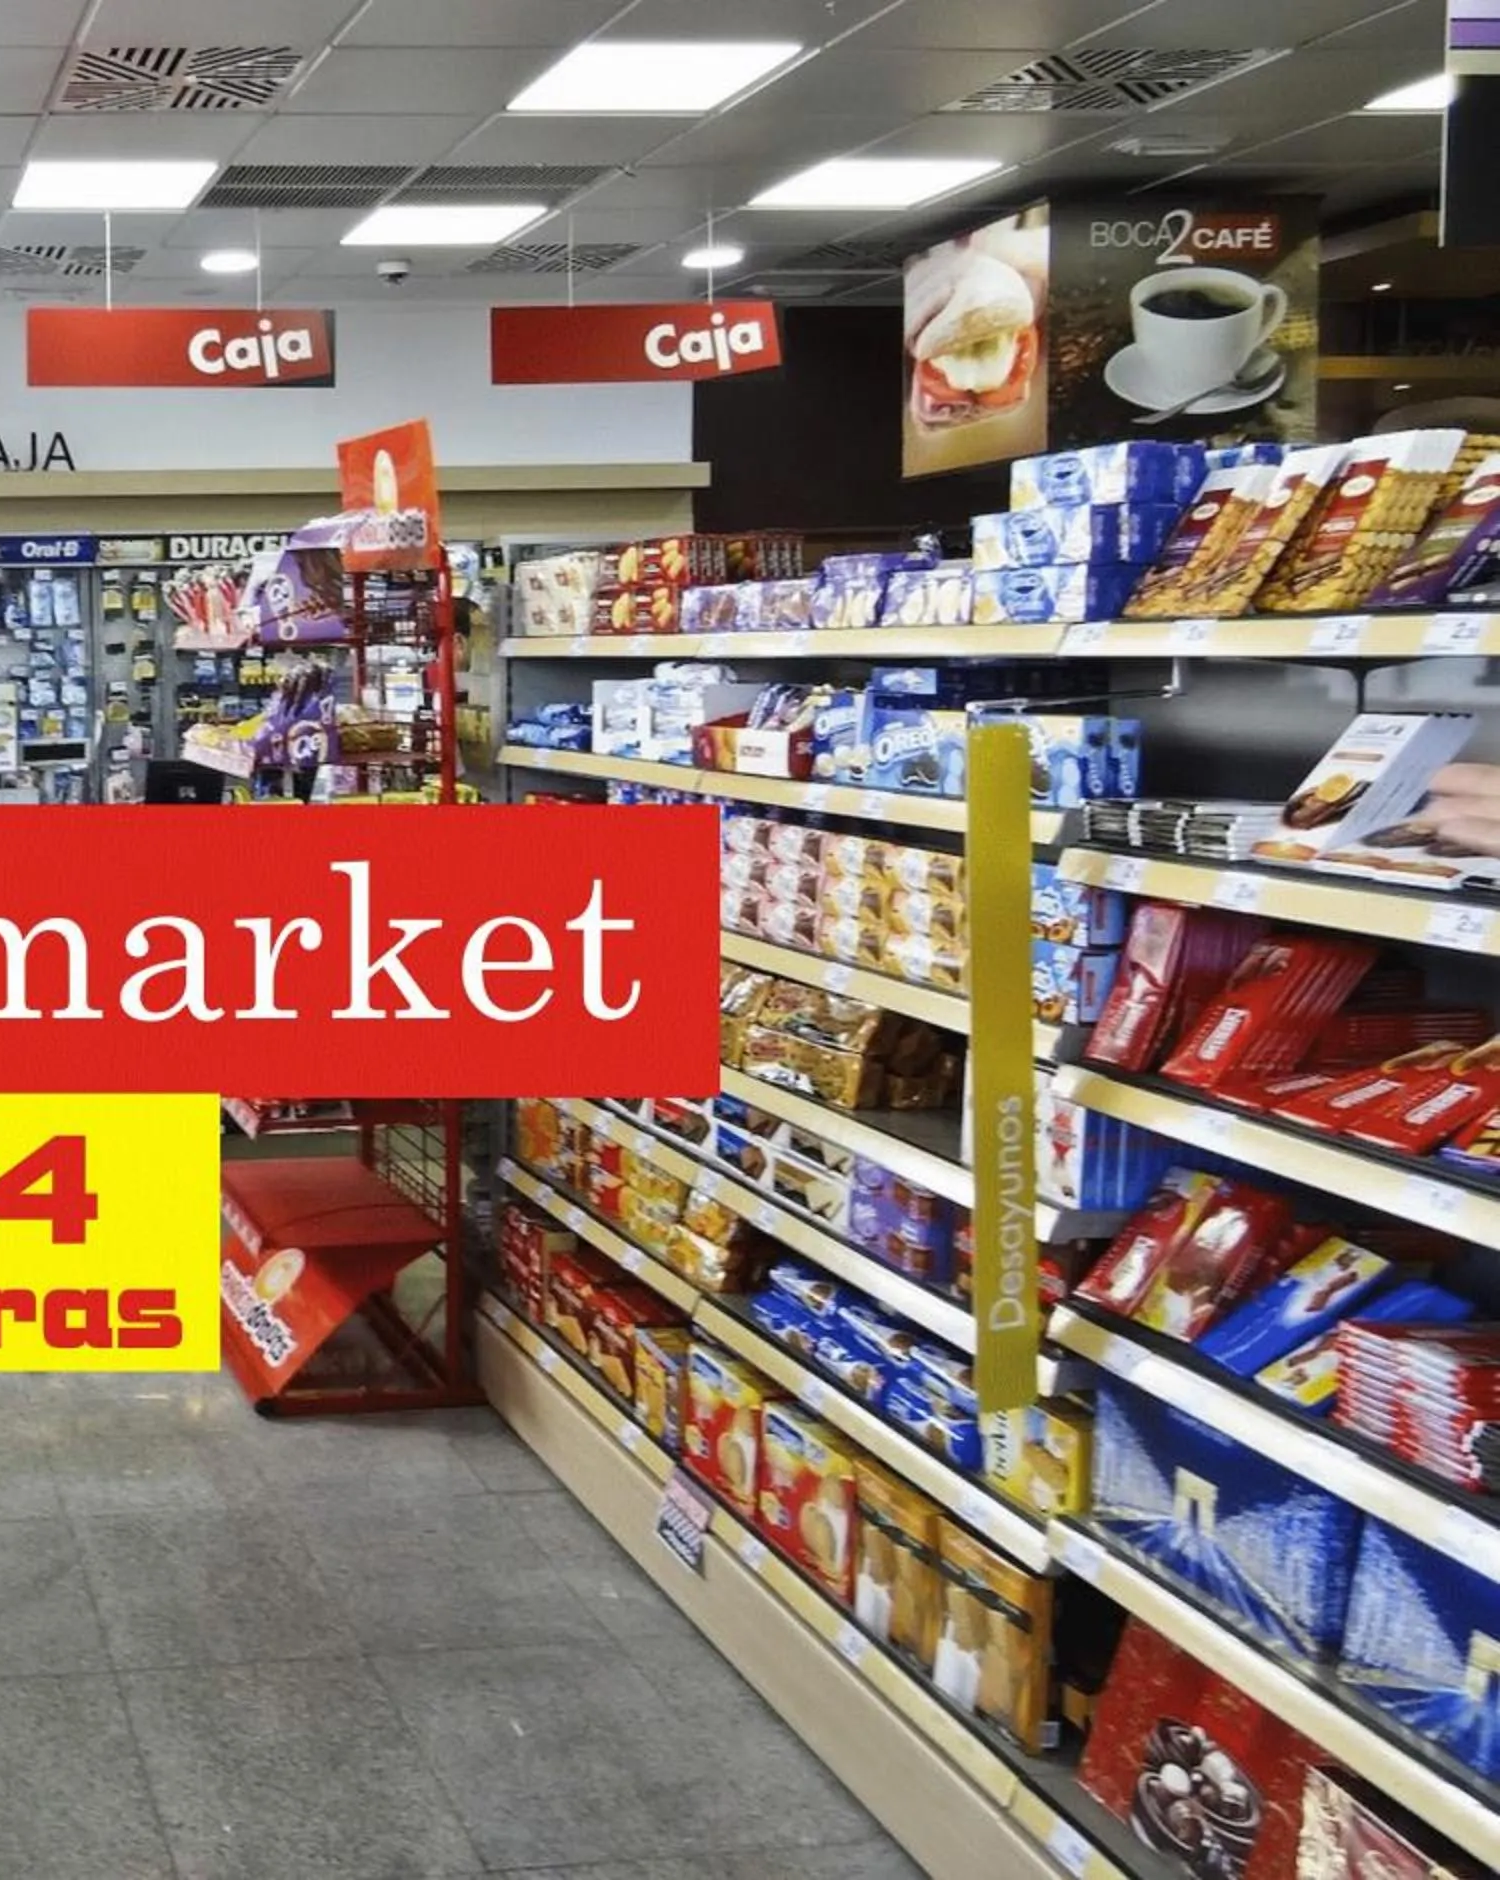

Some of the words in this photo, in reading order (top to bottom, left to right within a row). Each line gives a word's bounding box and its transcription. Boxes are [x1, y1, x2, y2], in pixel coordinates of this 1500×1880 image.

[1090, 221, 1174, 248] BOCA
[1155, 209, 1195, 264] 2
[1192, 218, 1274, 250] CAFÉ
[188, 318, 313, 379] Caja
[644, 312, 764, 371] Caja
[21, 540, 80, 558] Oral-B
[169, 536, 289, 559] DURACE
[989, 1095, 1034, 1331] Desayunos
